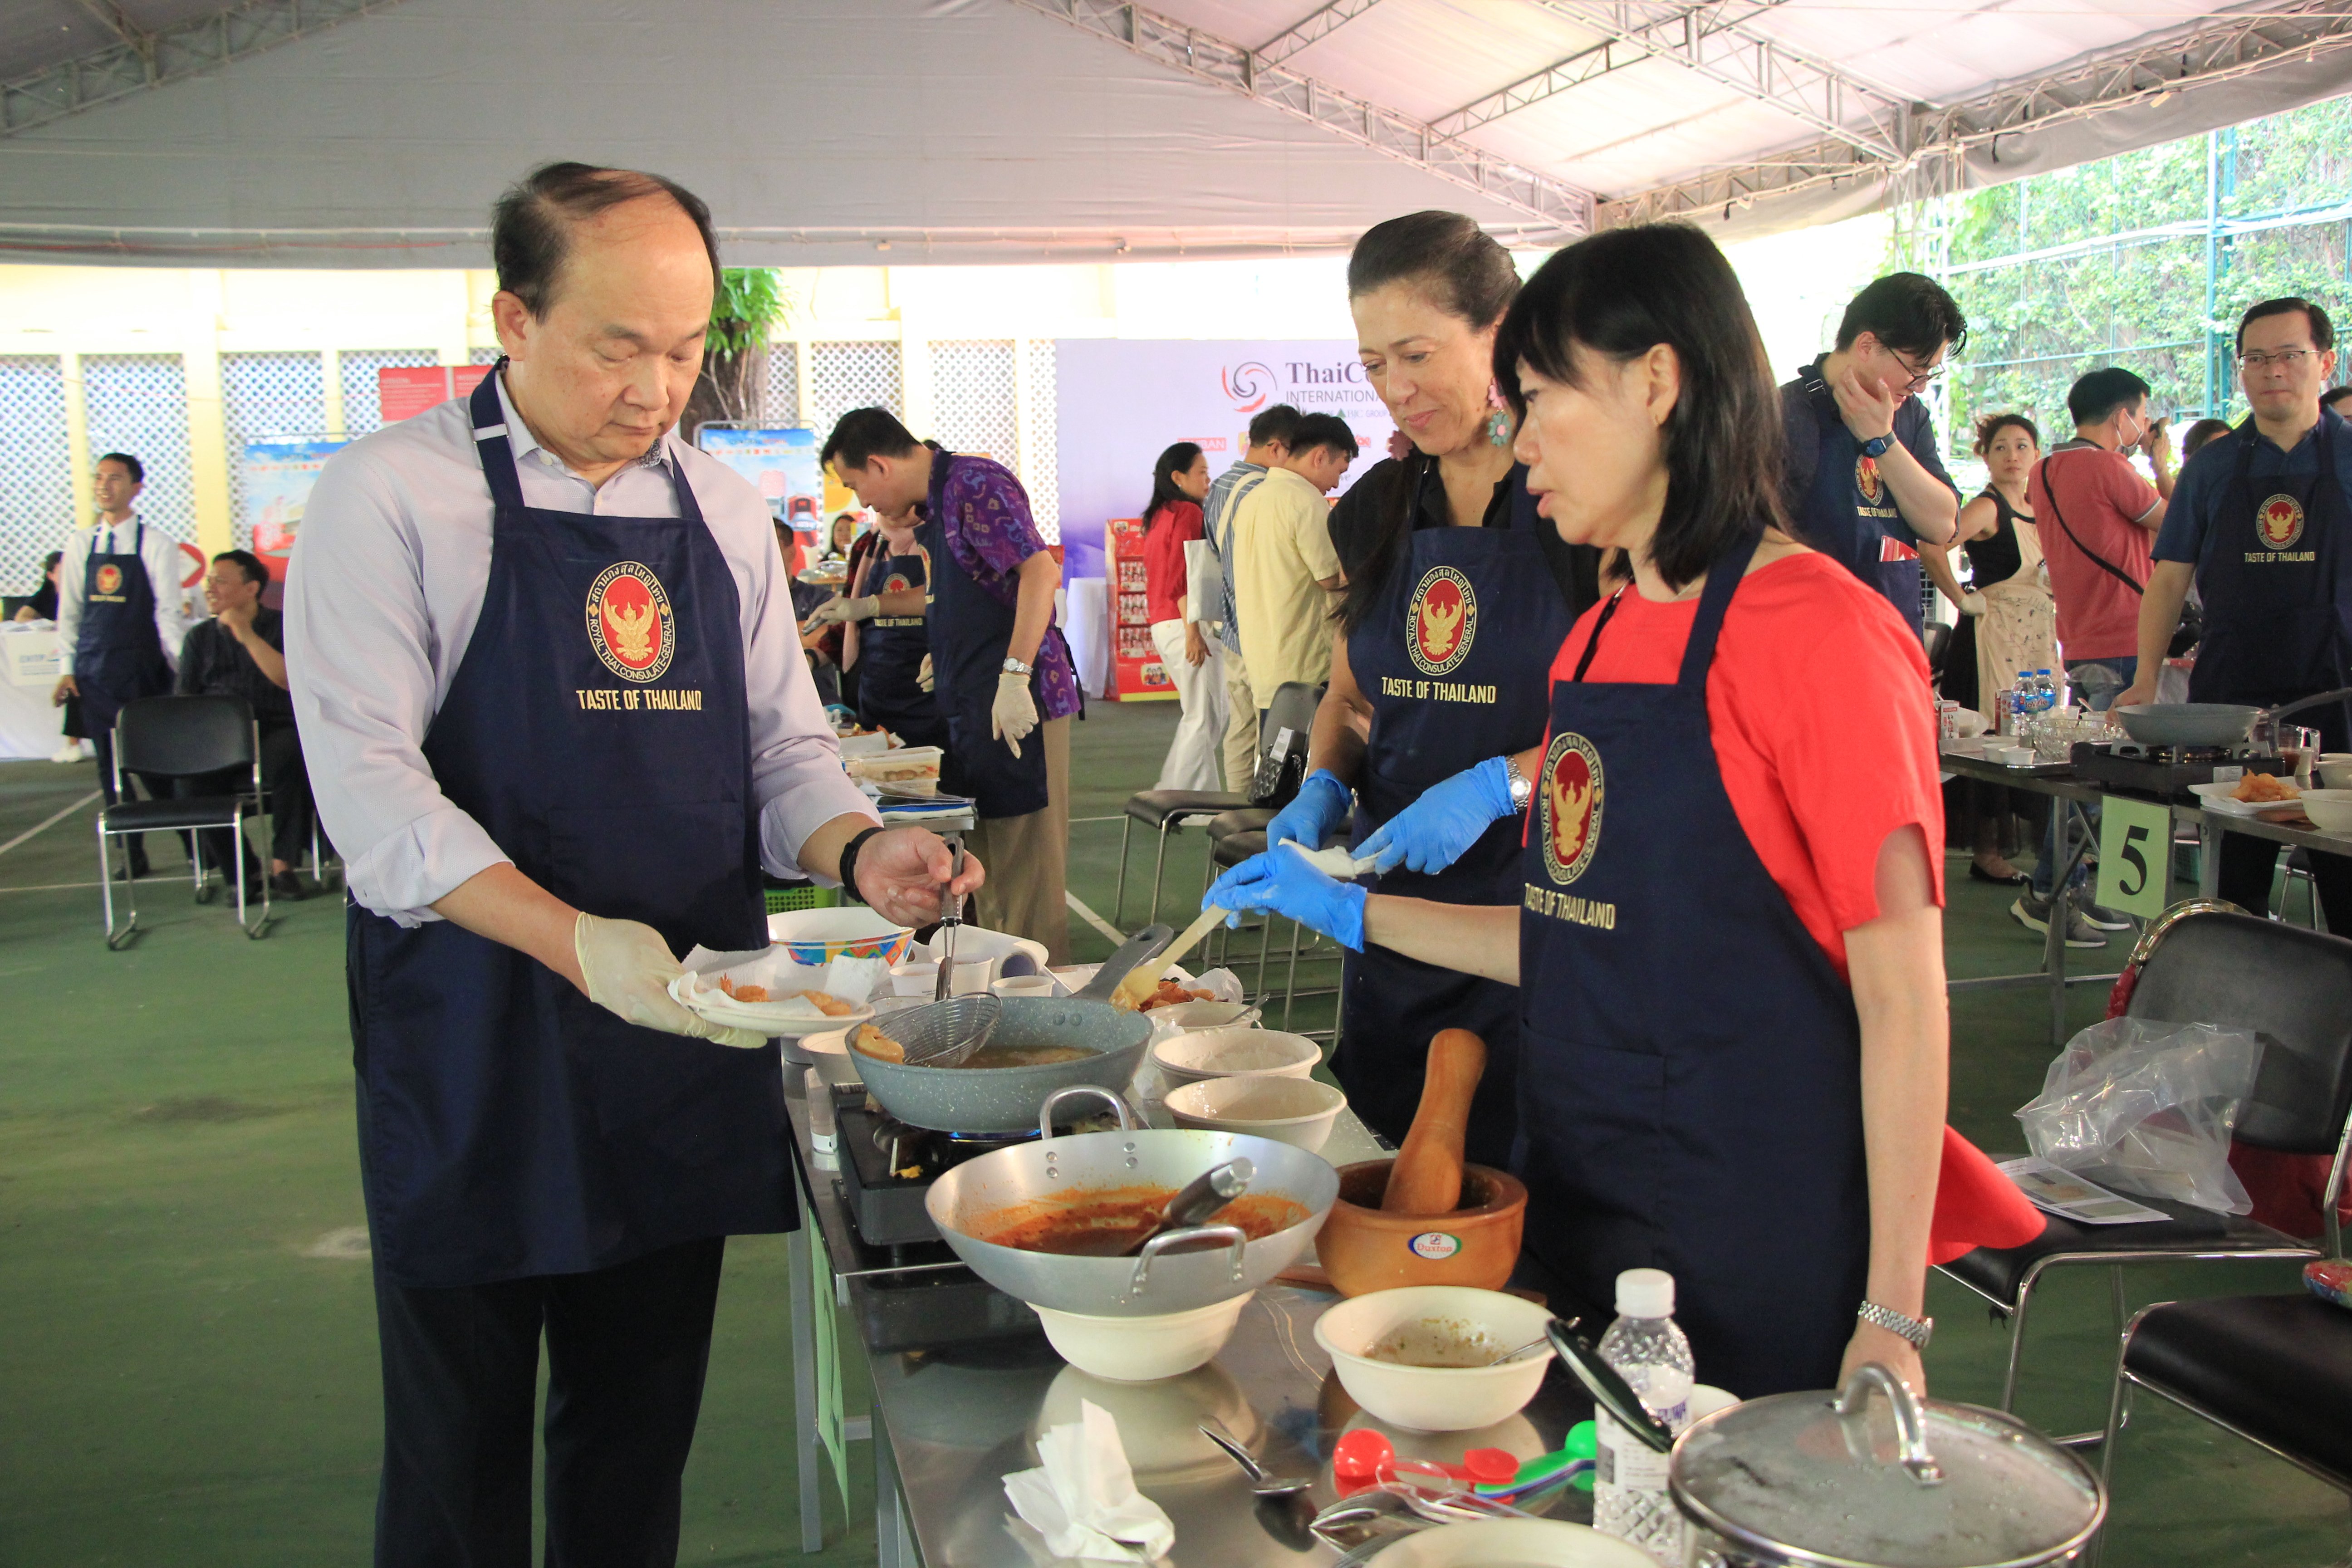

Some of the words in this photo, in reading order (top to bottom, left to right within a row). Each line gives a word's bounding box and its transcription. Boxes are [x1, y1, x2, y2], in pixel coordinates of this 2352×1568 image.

[1285, 361, 1371, 384] ThaiC
[2244, 552, 2265, 563] TASTE
[2266, 552, 2277, 562] OF
[2278, 551, 2316, 562] THAILAND
[589, 618, 604, 652] ROYAL
[602, 648, 621, 671] THAI
[619, 617, 672, 680] CONSULATE-GENERAL
[1410, 642, 1422, 662] THAI
[1419, 617, 1474, 673] CONSULATE-GENERAL
[576, 689, 622, 710] TASTE
[622, 690, 640, 710] OF
[643, 689, 702, 711] THAILAND
[1381, 676, 1413, 698] TASTE
[1416, 681, 1431, 699] OF
[1432, 682, 1497, 704] THAILAND
[2119, 825, 2149, 896] 5
[1544, 889, 1557, 916] OF
[1556, 892, 1617, 930] THAILAND
